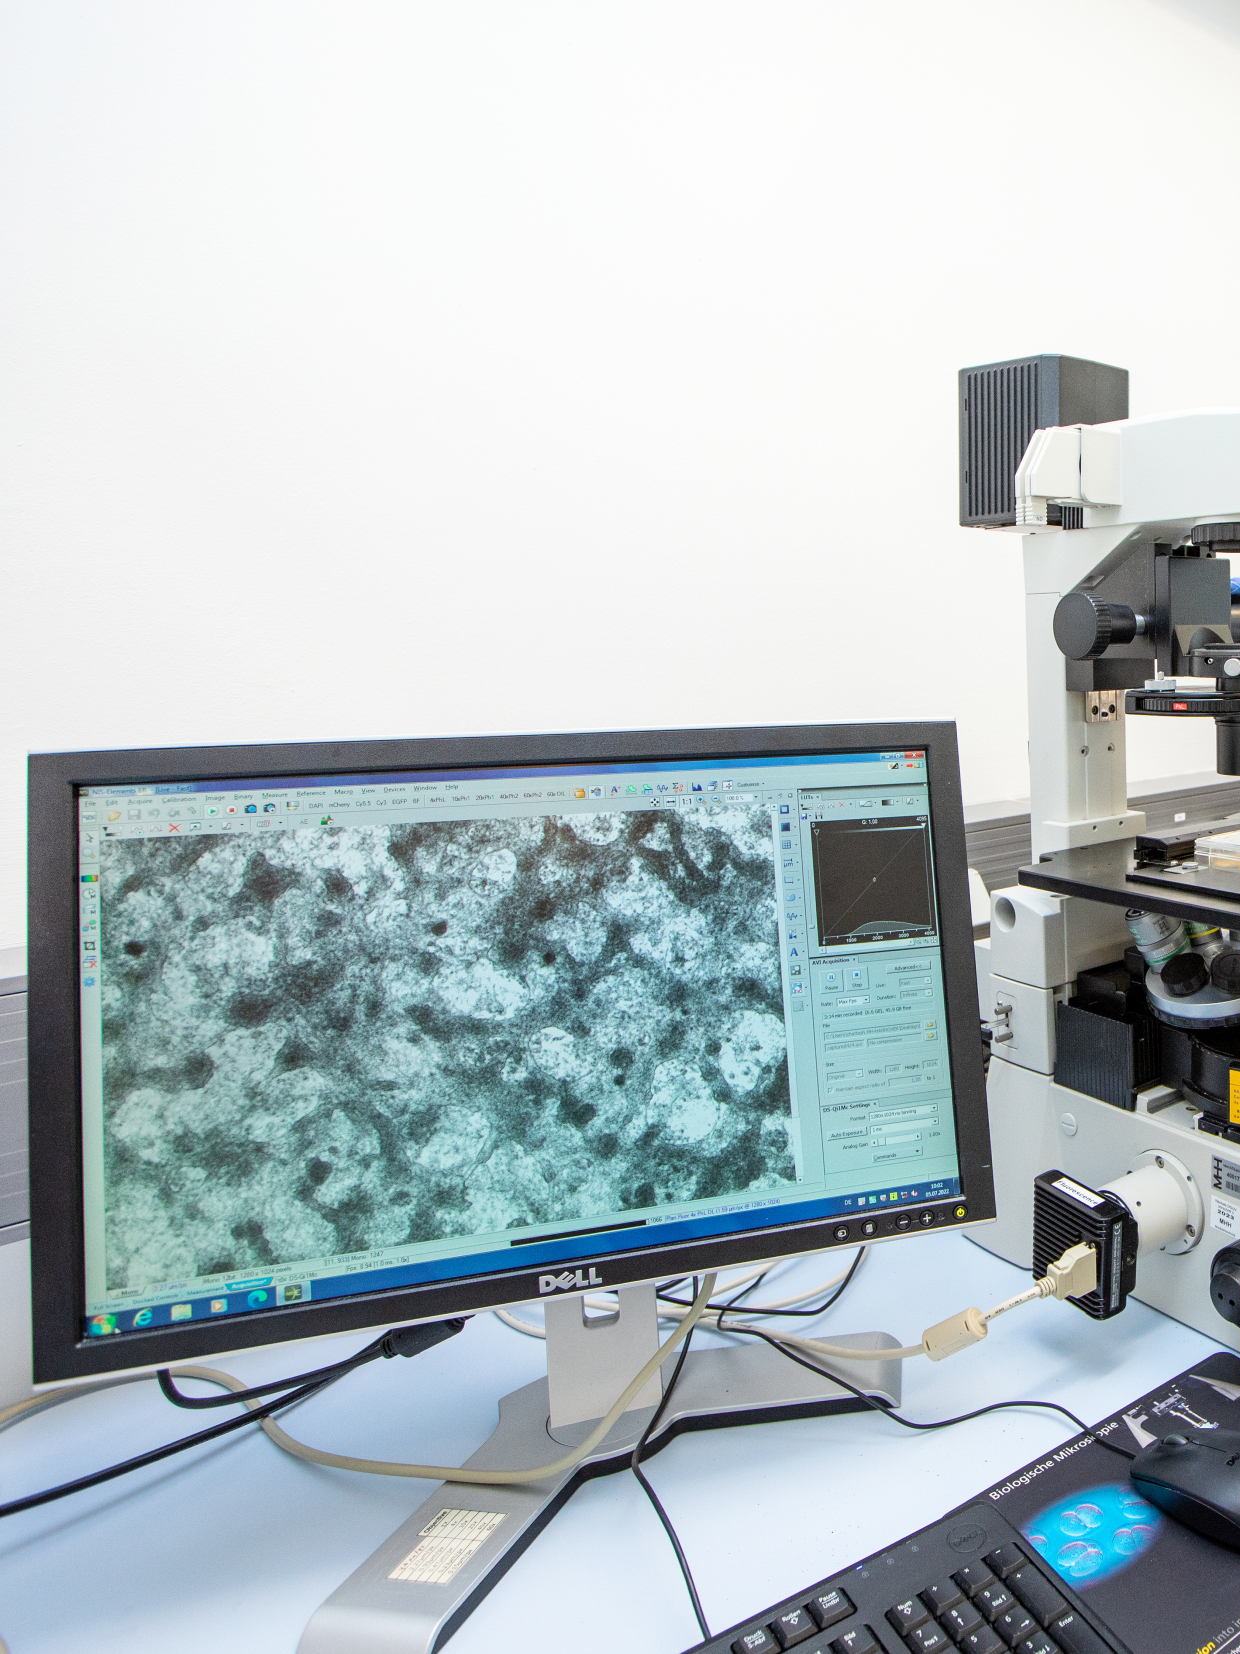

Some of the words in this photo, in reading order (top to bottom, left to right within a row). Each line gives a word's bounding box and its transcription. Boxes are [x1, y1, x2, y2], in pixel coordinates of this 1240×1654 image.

[1214, 1158, 1222, 1189] MHH
[1057, 1180, 1098, 1205] Fluorescence
[1217, 1209, 1234, 1220] 2023
[1220, 1218, 1232, 1228] MHH
[276, 1266, 292, 1274] pixels
[538, 1267, 602, 1294] DELL
[187, 1286, 224, 1295] Measurement
[988, 1460, 1054, 1500] Biologische
[424, 1510, 448, 1534] Objective
[819, 1591, 837, 1602] Pause
[992, 1597, 1003, 1606] Bild
[823, 1598, 840, 1608] Untbr
[897, 1601, 912, 1611] Num
[782, 1610, 801, 1622] Rollen
[1059, 1616, 1073, 1627] Enter
[743, 1630, 762, 1642] Druck
[916, 1630, 922, 1638] 7
[970, 1635, 978, 1643] 5
[1213, 1626, 1234, 1644] into
[924, 1635, 938, 1647] Pos1
[1026, 1641, 1033, 1649] 3
